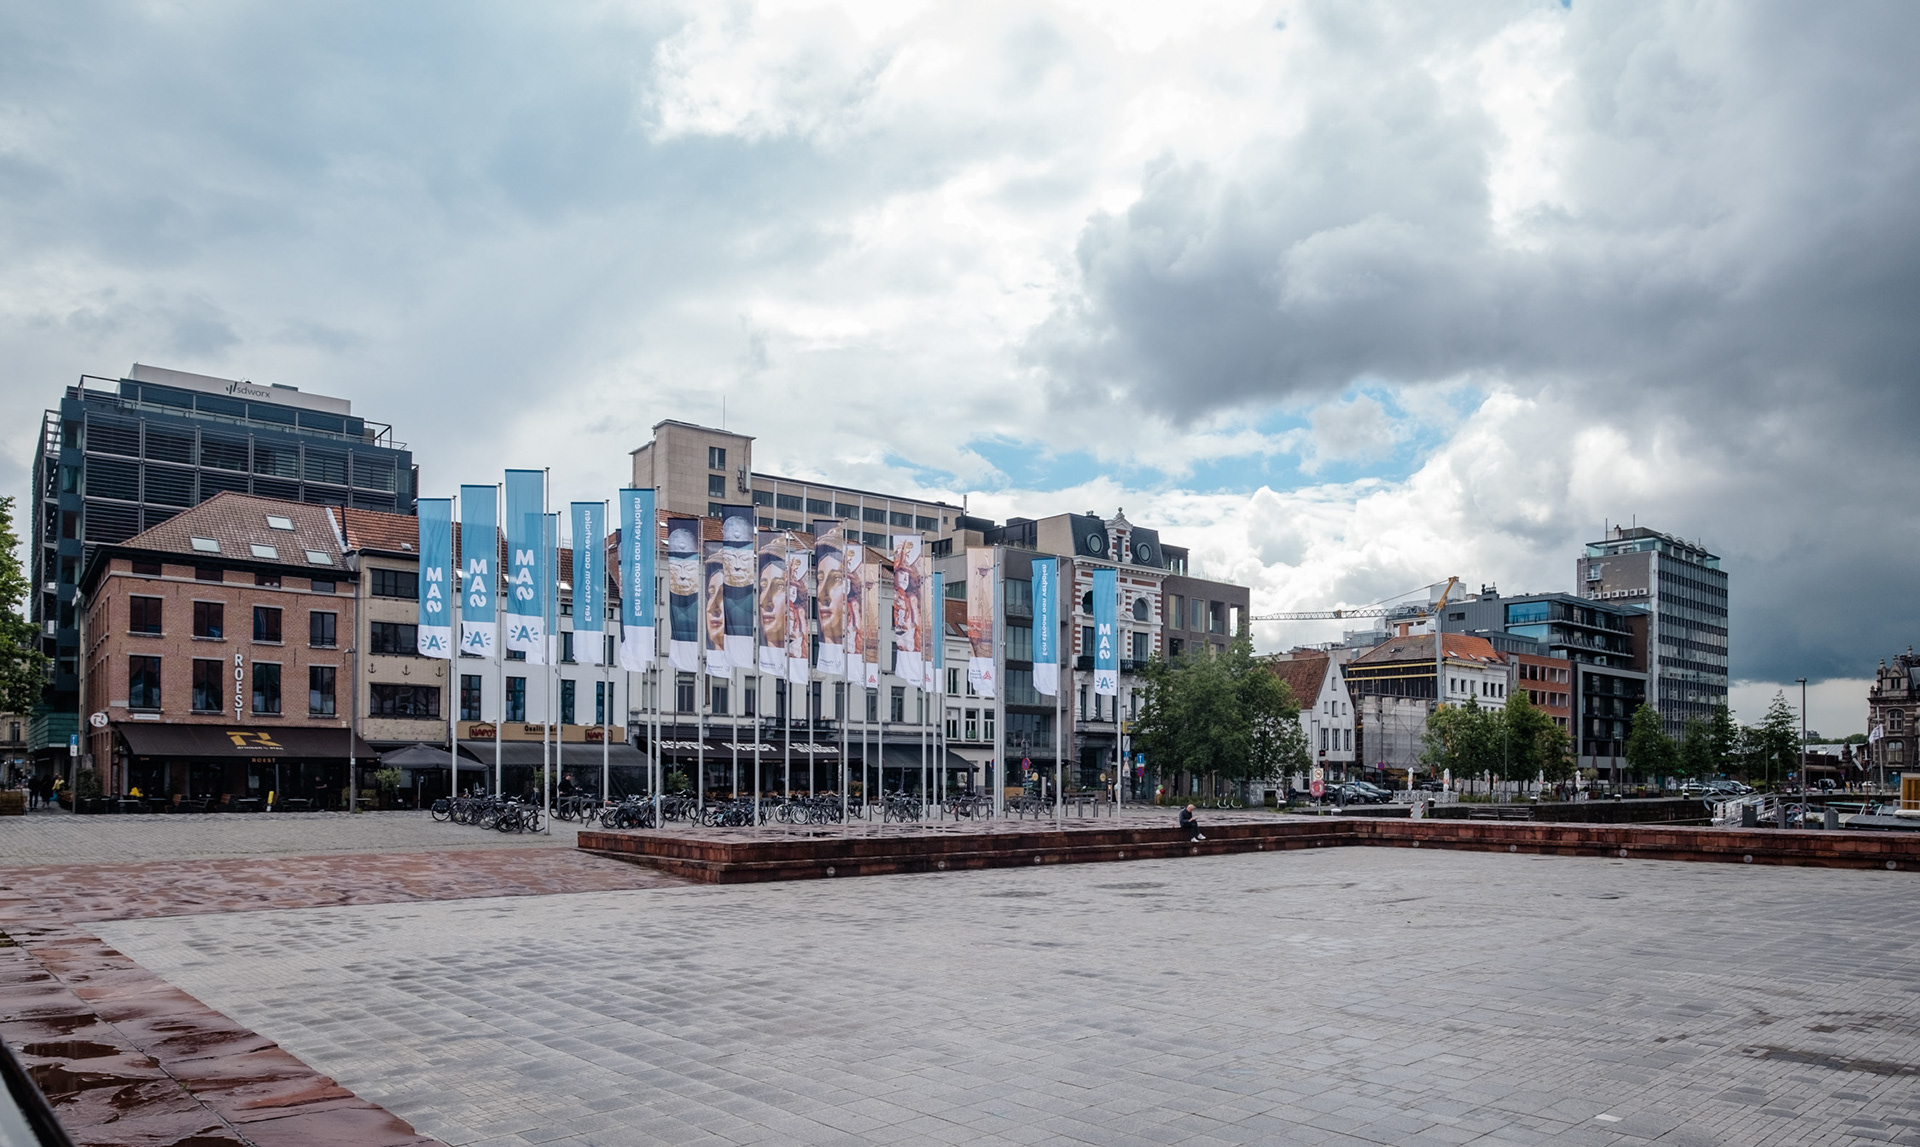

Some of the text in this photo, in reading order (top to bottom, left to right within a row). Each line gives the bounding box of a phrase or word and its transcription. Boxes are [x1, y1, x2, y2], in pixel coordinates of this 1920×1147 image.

[237, 387, 271, 398] sdworx
[234, 653, 244, 721] ROEST
[524, 725, 545, 733] Qualit
[587, 732, 611, 740] NAPO
